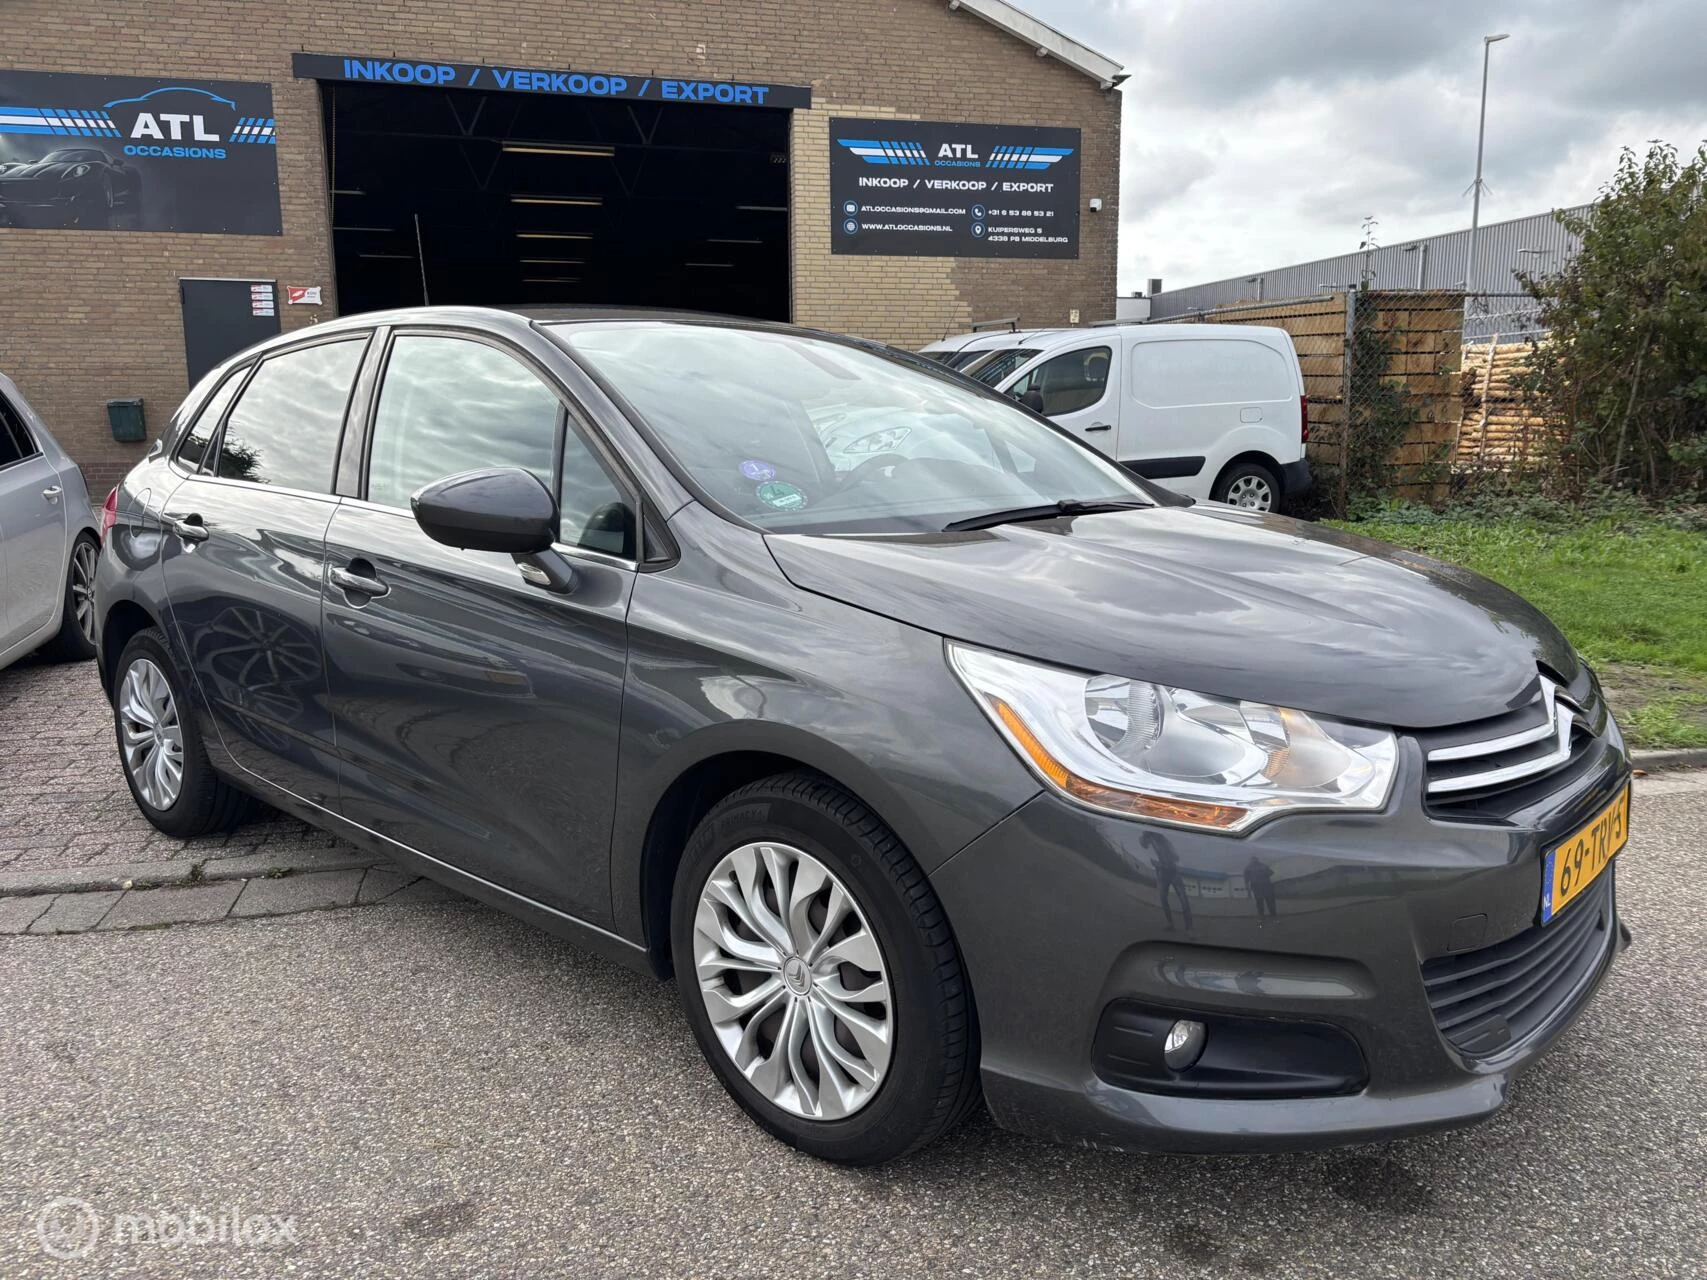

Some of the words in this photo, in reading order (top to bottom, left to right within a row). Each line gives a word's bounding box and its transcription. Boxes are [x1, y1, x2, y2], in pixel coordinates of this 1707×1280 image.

[343, 59, 456, 86] INKOOP
[467, 69, 480, 87] /
[491, 69, 628, 96] VERKOOP
[637, 79, 651, 97] /
[661, 79, 769, 105] EXPORT
[130, 112, 220, 142] ATL
[123, 144, 227, 159] OCCASIONS
[937, 143, 979, 159] ATL
[934, 159, 981, 168] OCCASIONS
[858, 176, 909, 188] INKOOP
[912, 178, 920, 189] /
[924, 179, 987, 191] VERKOOP
[990, 181, 998, 191] /
[1002, 181, 1054, 193] EXPORT
[861, 223, 953, 232] WWW.ATLOCCASIONS.NL
[1543, 895, 1552, 911] NL
